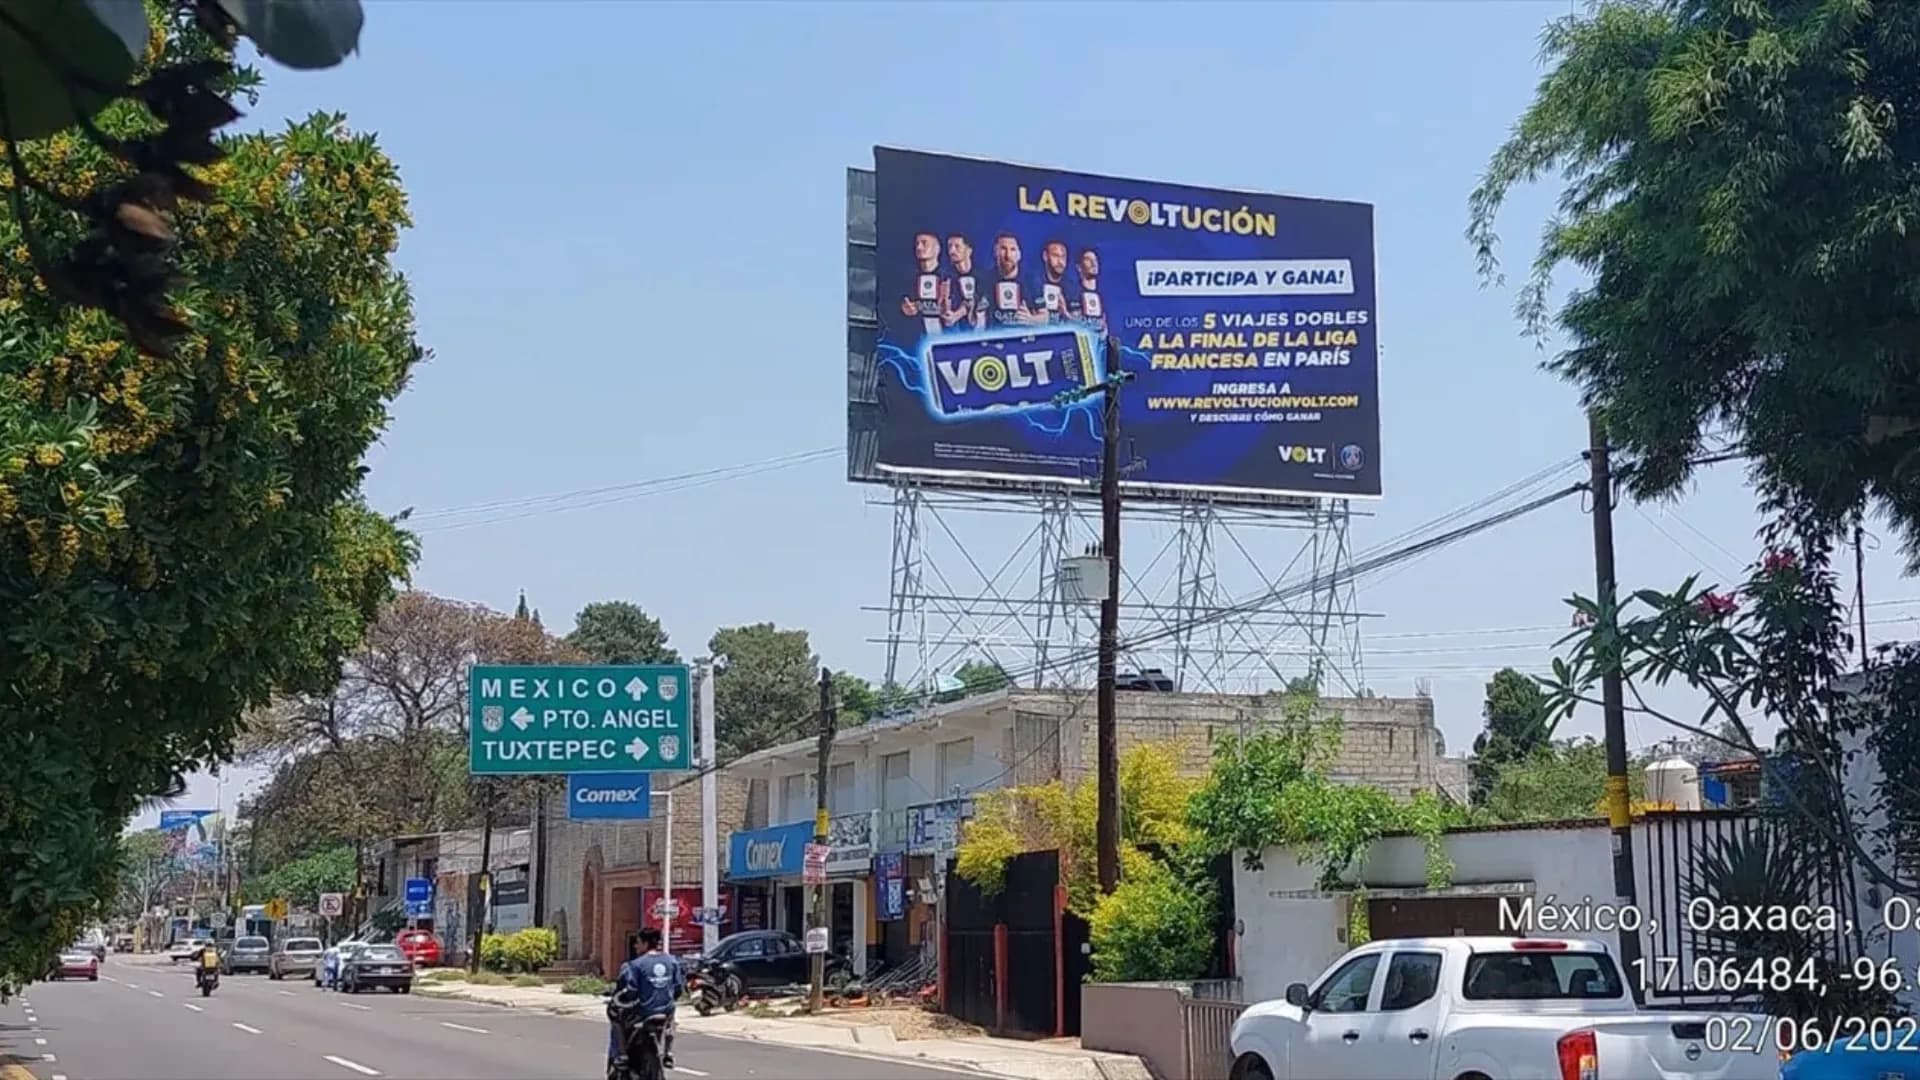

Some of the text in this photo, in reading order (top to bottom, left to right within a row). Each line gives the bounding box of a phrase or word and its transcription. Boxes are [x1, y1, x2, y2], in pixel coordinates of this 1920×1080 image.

[1018, 187, 1276, 237] LA REVOLTUCIÓN
[1147, 269, 1344, 286] ¡PARTICIPA Y GANA!
[1125, 310, 1368, 329] UNO DE LOS 5 VIAJES DOBLES
[1138, 330, 1358, 349] A LA FINAL DE LA LIGA
[1151, 348, 1351, 370] FRANCESA EN PARÍS
[937, 350, 1054, 395] VOLT
[1212, 383, 1291, 394] INGRESA A
[1147, 395, 1359, 409] WWW.REVOLTUCIONVOLT.COM
[1198, 412, 1252, 422] DESCUBRE
[1286, 412, 1321, 421] GANAR
[1278, 445, 1327, 464] VOLT
[481, 678, 617, 698] MEXICO
[543, 709, 679, 729] PTO. ANGEL
[481, 739, 617, 760] TUXTEPEC
[575, 787, 643, 803] Comex
[745, 835, 787, 870] Comex
